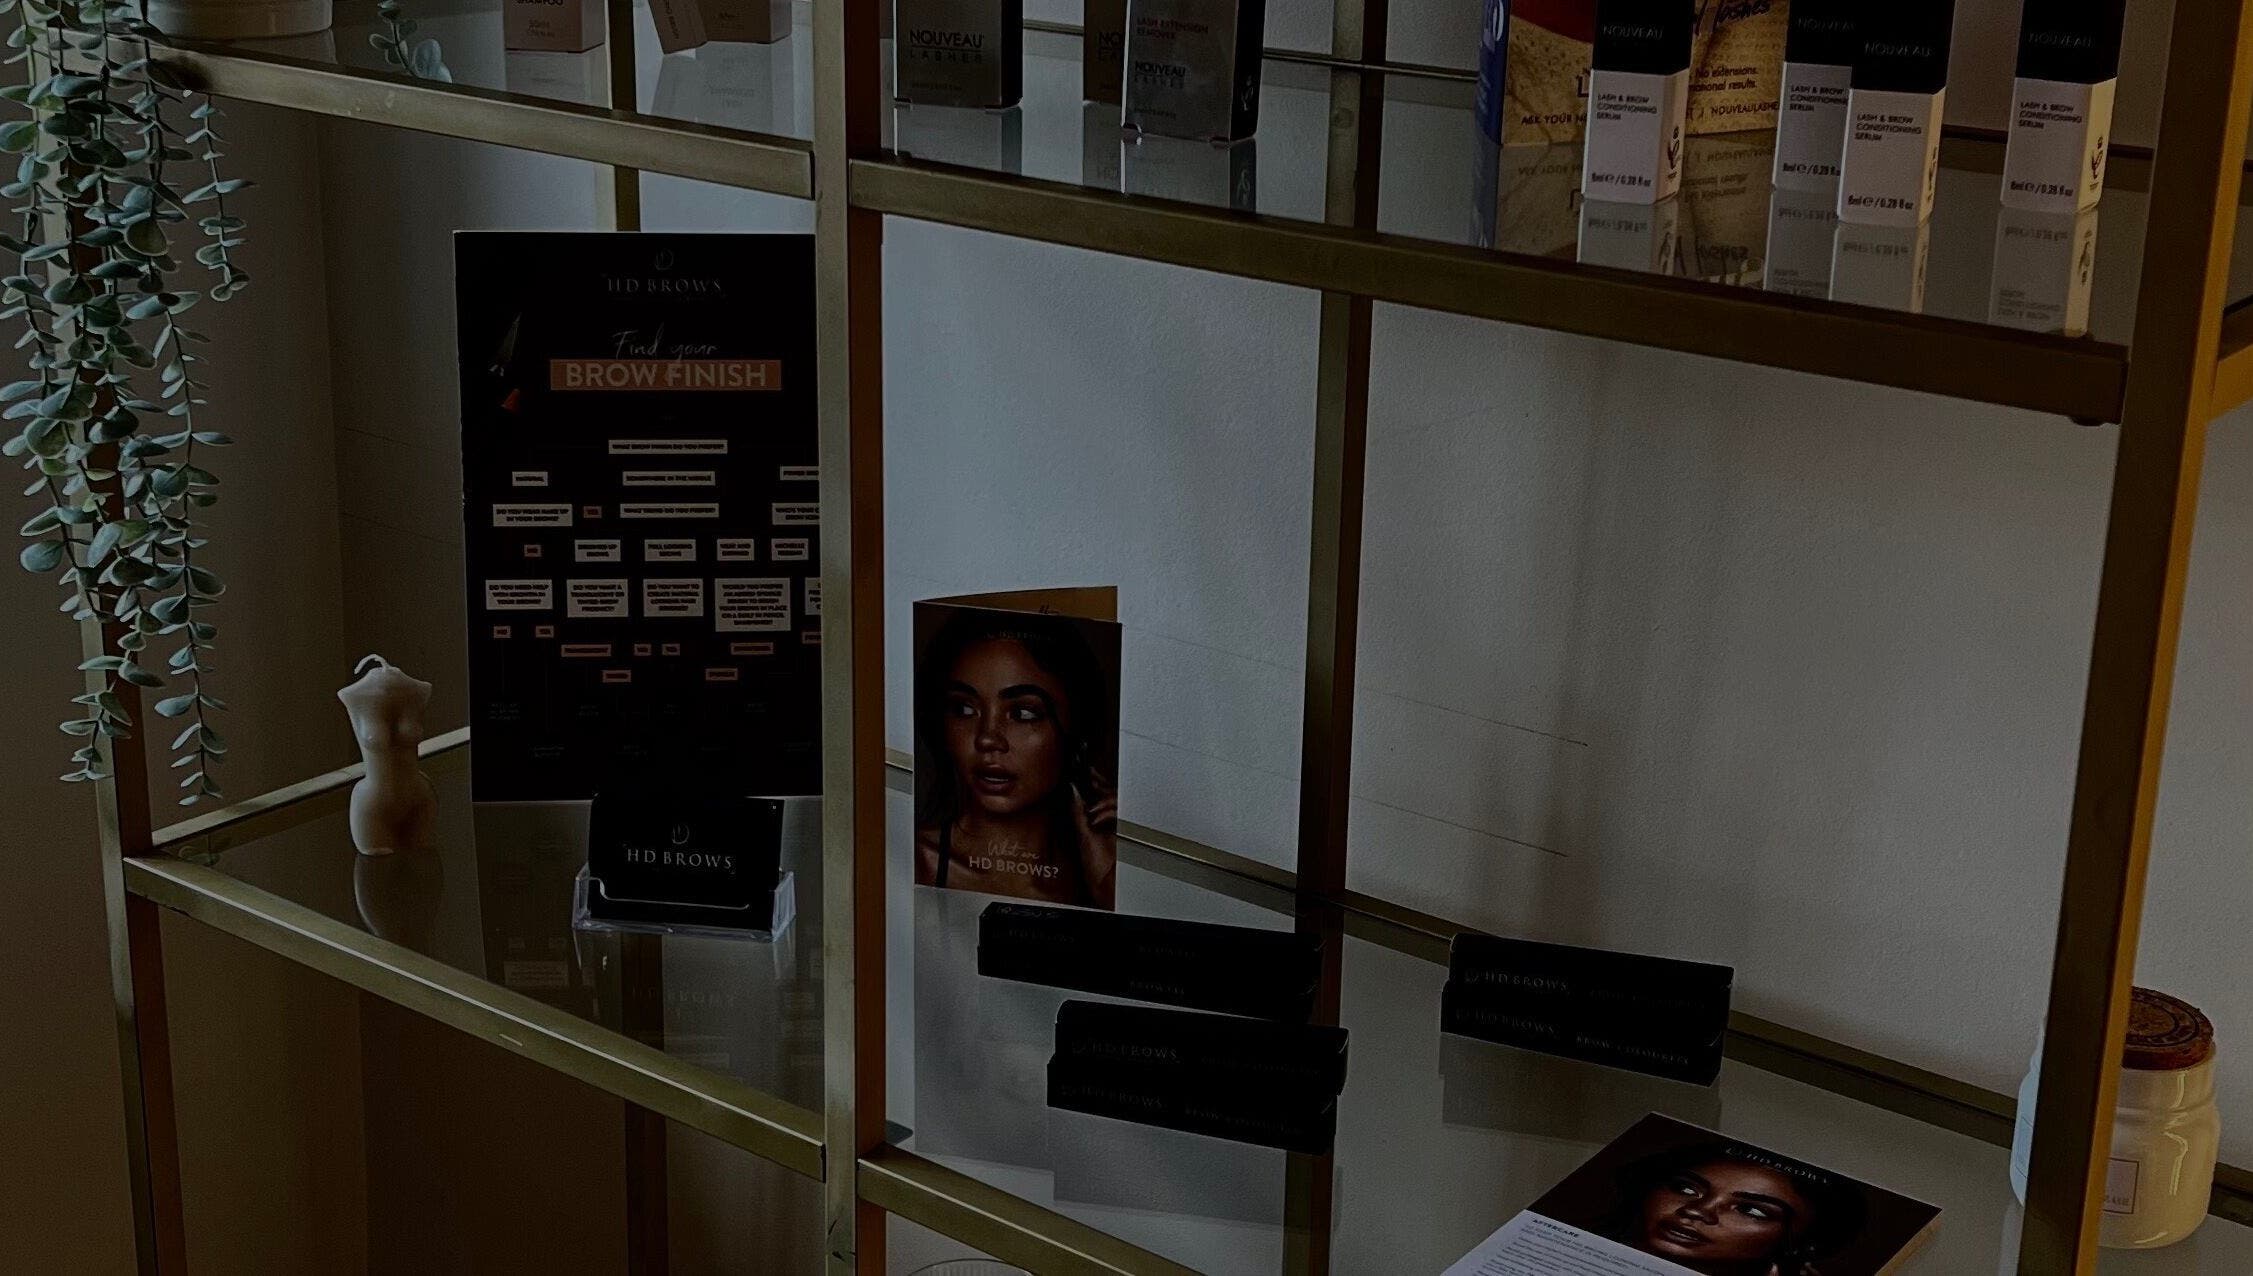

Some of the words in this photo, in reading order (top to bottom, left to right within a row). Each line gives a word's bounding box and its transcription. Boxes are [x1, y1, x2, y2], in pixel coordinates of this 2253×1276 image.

[1603, 24, 1663, 39] NOUVEAU
[909, 29, 983, 49] NOUVEAU
[2029, 31, 2092, 48] NOUVEAU
[1864, 40, 1930, 57] NOUVEAU
[1134, 61, 1187, 78] NOUVEAU
[1791, 85, 1810, 93] LASH
[1820, 86, 1844, 95] BROW
[1626, 95, 1650, 103] BROW
[1596, 103, 1657, 114] CONDITIONING
[1789, 103, 1814, 112] SERUM
[2020, 102, 2041, 110] LASH
[2050, 104, 2074, 112] BROW
[1596, 112, 1622, 120] SERUM
[1857, 113, 1878, 121] LASH
[1888, 115, 1914, 124] BROW
[2019, 110, 2082, 123] CONDITIONING
[1856, 122, 1922, 135] CONDITIONING
[2018, 119, 2045, 129] SERUM
[1855, 132, 1882, 141] SERUM
[608, 278, 640, 293] HD
[648, 278, 721, 293] BROWS
[611, 320, 665, 359] Find
[671, 342, 720, 361] your
[565, 363, 657, 387] BROW
[665, 363, 766, 387] FINISH
[627, 848, 656, 864] HD
[664, 851, 732, 870] BROWS
[969, 856, 992, 870] HD
[996, 859, 1059, 879] BROWS?
[1532, 1218, 1580, 1238] AFTERCARE
